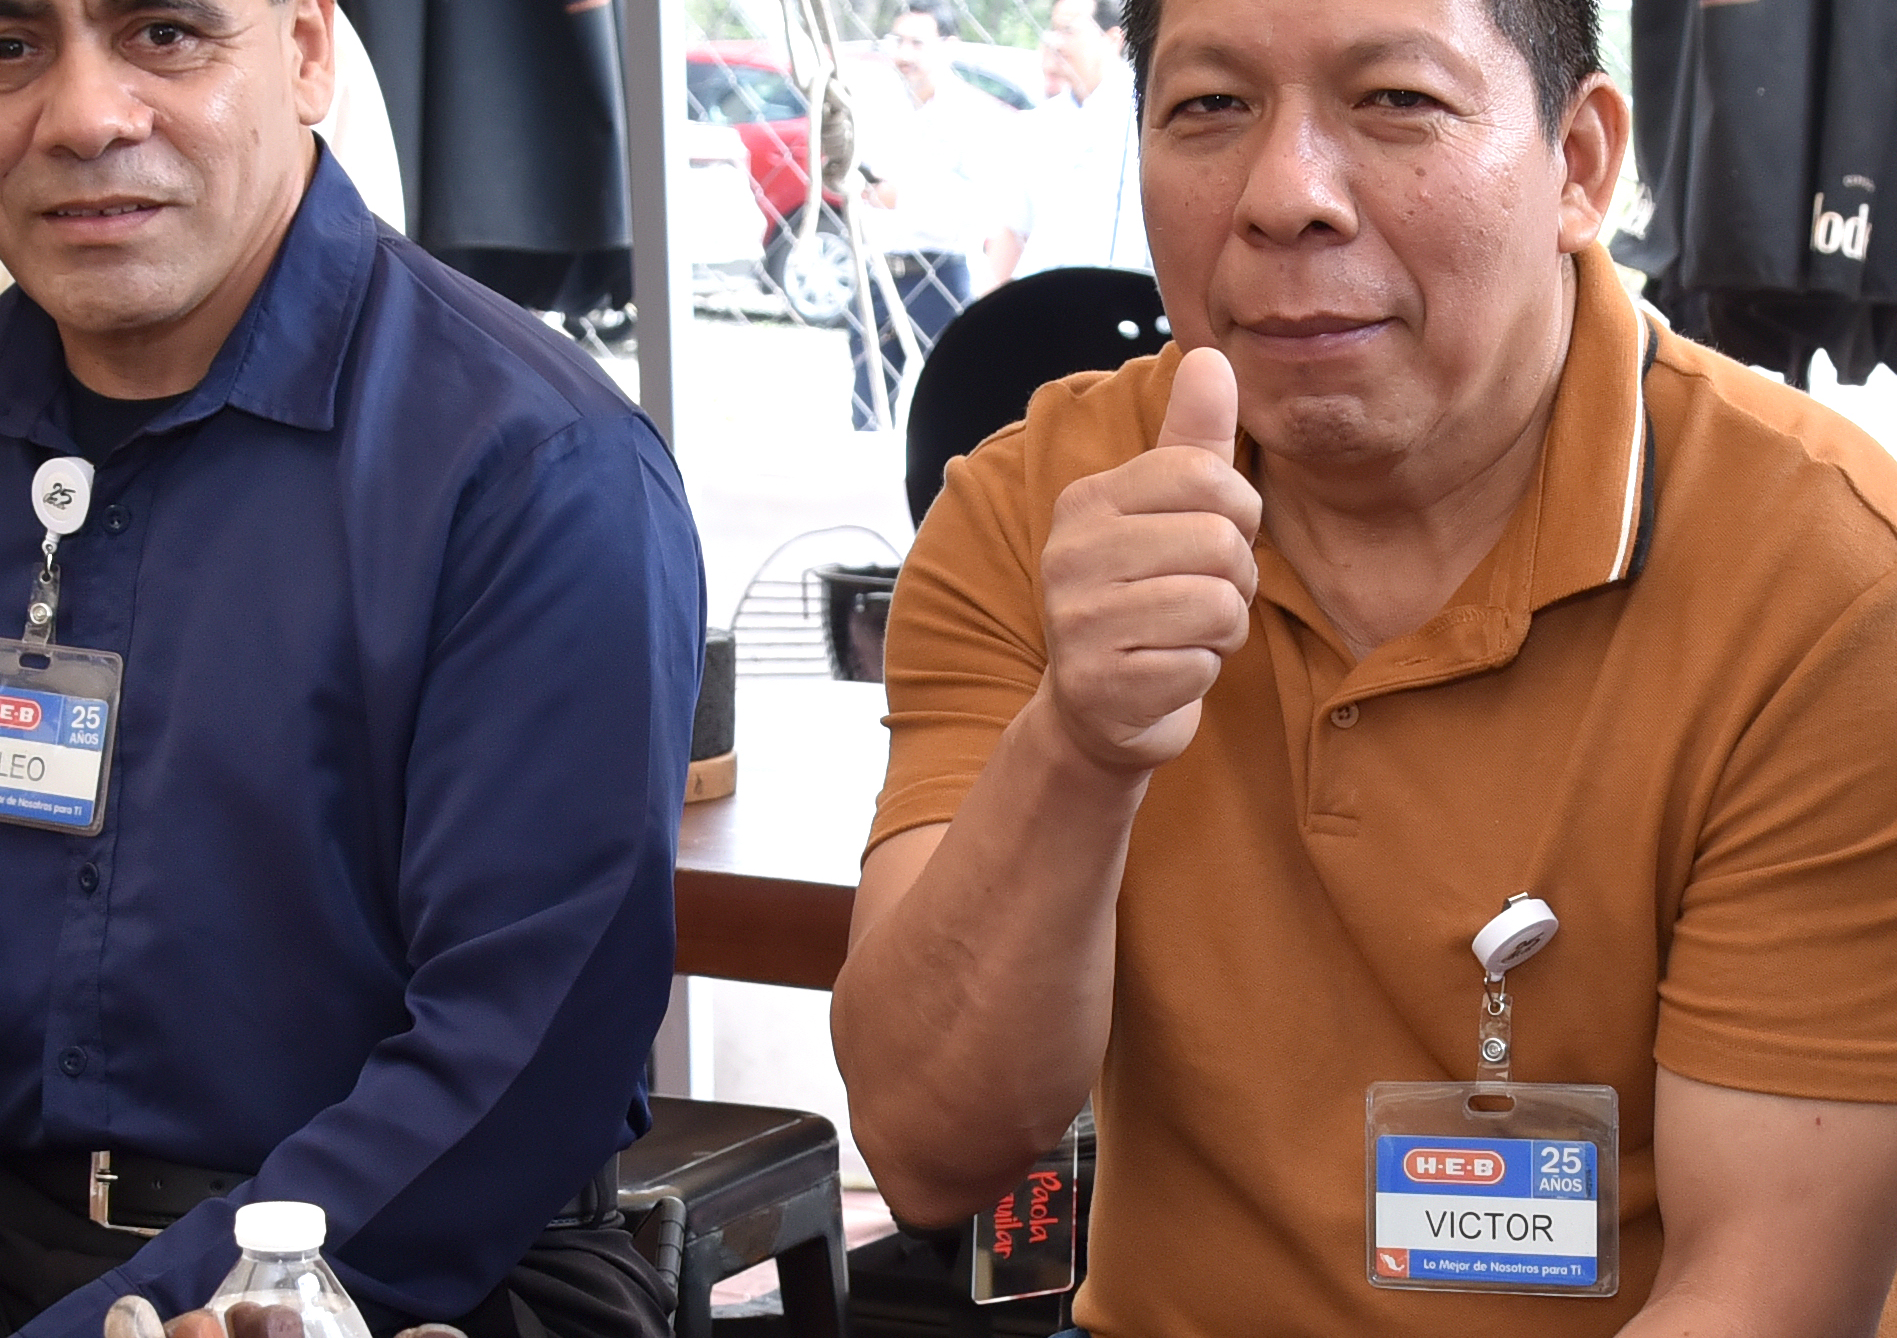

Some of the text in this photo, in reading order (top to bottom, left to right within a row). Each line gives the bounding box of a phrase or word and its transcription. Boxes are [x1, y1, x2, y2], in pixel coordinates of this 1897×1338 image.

[70, 705, 101, 729] 25
[69, 730, 99, 745] AÑOS
[6, 794, 17, 806] de
[18, 797, 53, 812] Nosotros
[53, 804, 73, 815] para
[1540, 1146, 1582, 1174] 25
[1539, 1175, 1582, 1192] AÑOS
[1027, 1171, 1062, 1244] Paola
[1424, 1209, 1554, 1243] VICTOR
[1423, 1258, 1436, 1269] Lo
[1439, 1259, 1470, 1273] Mejor
[1473, 1260, 1487, 1272] de
[1490, 1261, 1539, 1274] Nosotros
[1542, 1265, 1568, 1277] para
